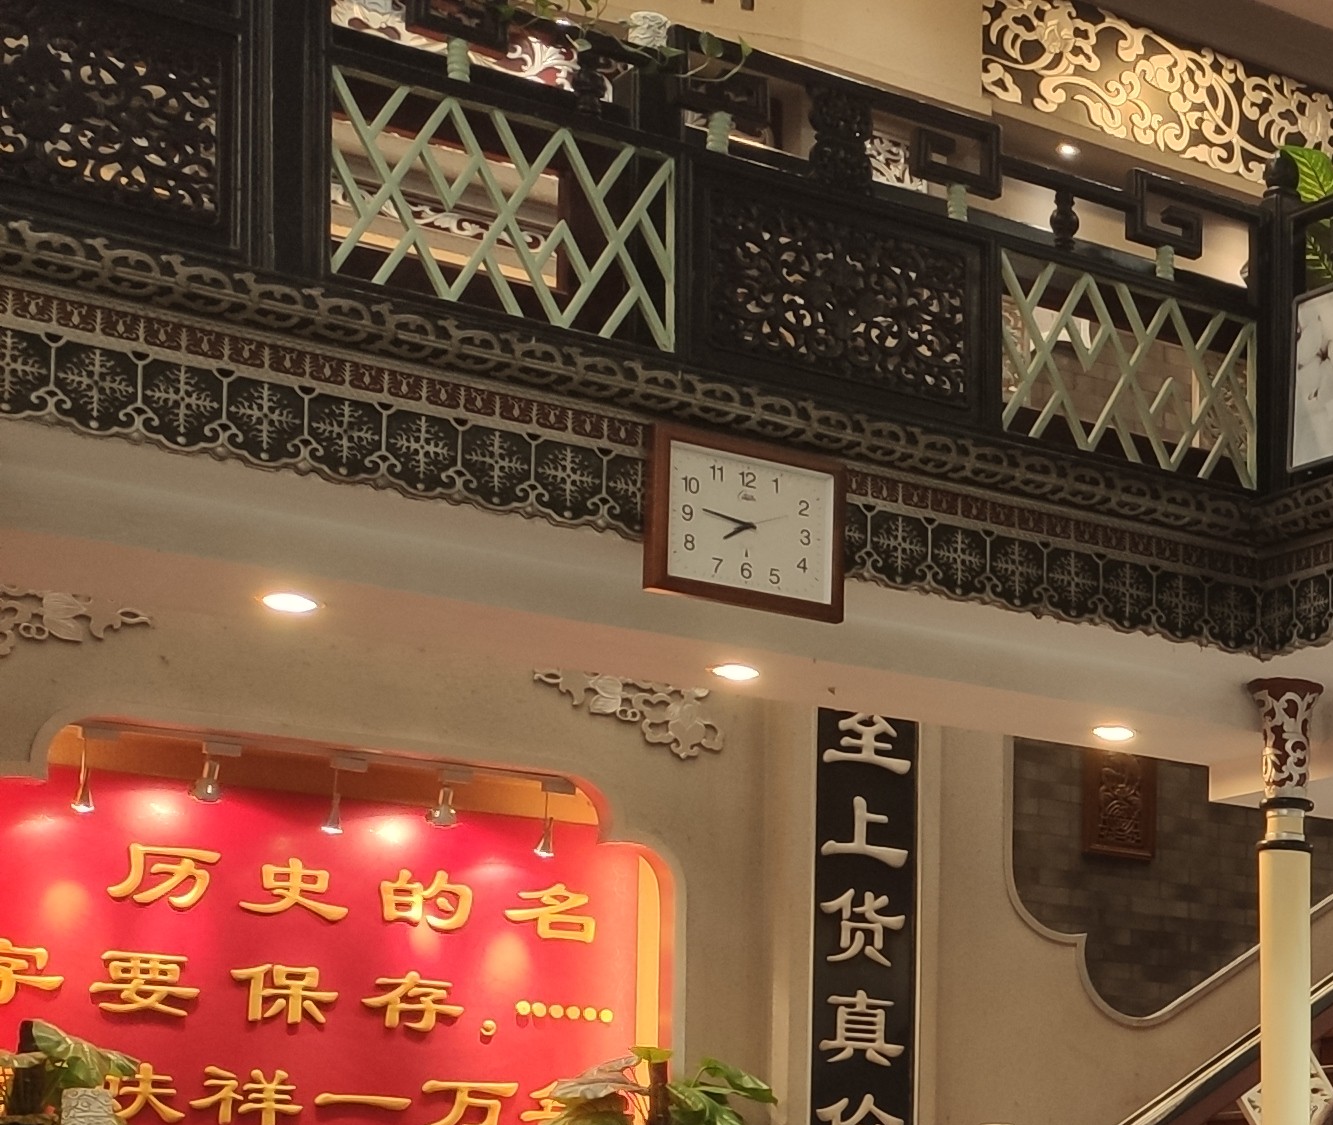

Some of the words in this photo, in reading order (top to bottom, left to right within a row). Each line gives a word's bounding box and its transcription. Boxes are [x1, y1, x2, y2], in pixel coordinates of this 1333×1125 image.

[709, 464, 724, 482] 11
[739, 472, 757, 489] 12
[681, 475, 700, 494] 10
[772, 478, 780, 494] 1
[681, 504, 694, 521] 9
[798, 500, 810, 517] 2
[683, 534, 696, 551] 8
[799, 529, 811, 546] 3
[712, 557, 723, 573] 7
[740, 562, 752, 579] 6
[796, 557, 808, 573] 4
[768, 568, 781, 585] 5
[107, 843, 596, 943] 历史的名
